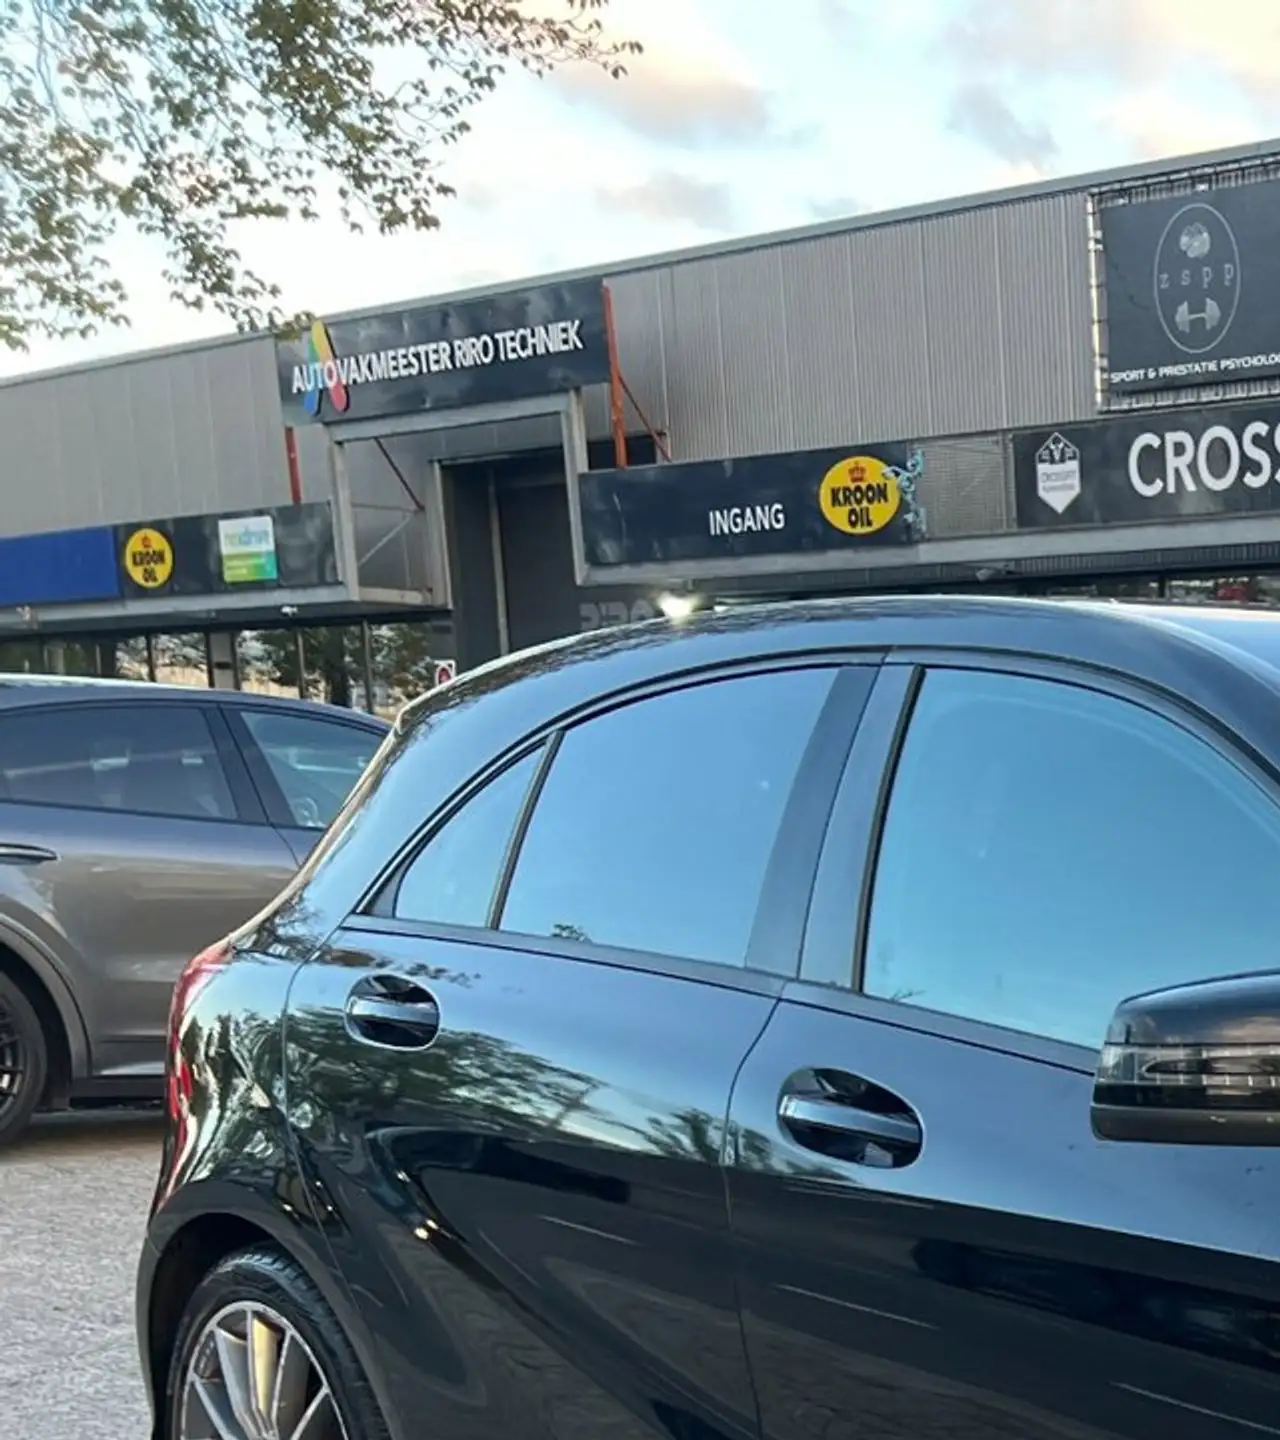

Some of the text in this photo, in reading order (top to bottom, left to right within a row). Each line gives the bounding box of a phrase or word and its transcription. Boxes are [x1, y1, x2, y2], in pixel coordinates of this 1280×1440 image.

[292, 319, 584, 393] AUTOVAKMEESTER RIRO TECHNIEK
[1110, 368, 1144, 384] SPORT
[1148, 368, 1157, 379] &
[1159, 360, 1218, 378] PRESTATIE
[831, 483, 888, 508] KROON
[709, 504, 785, 536] INGANG
[848, 506, 873, 529] OIL
